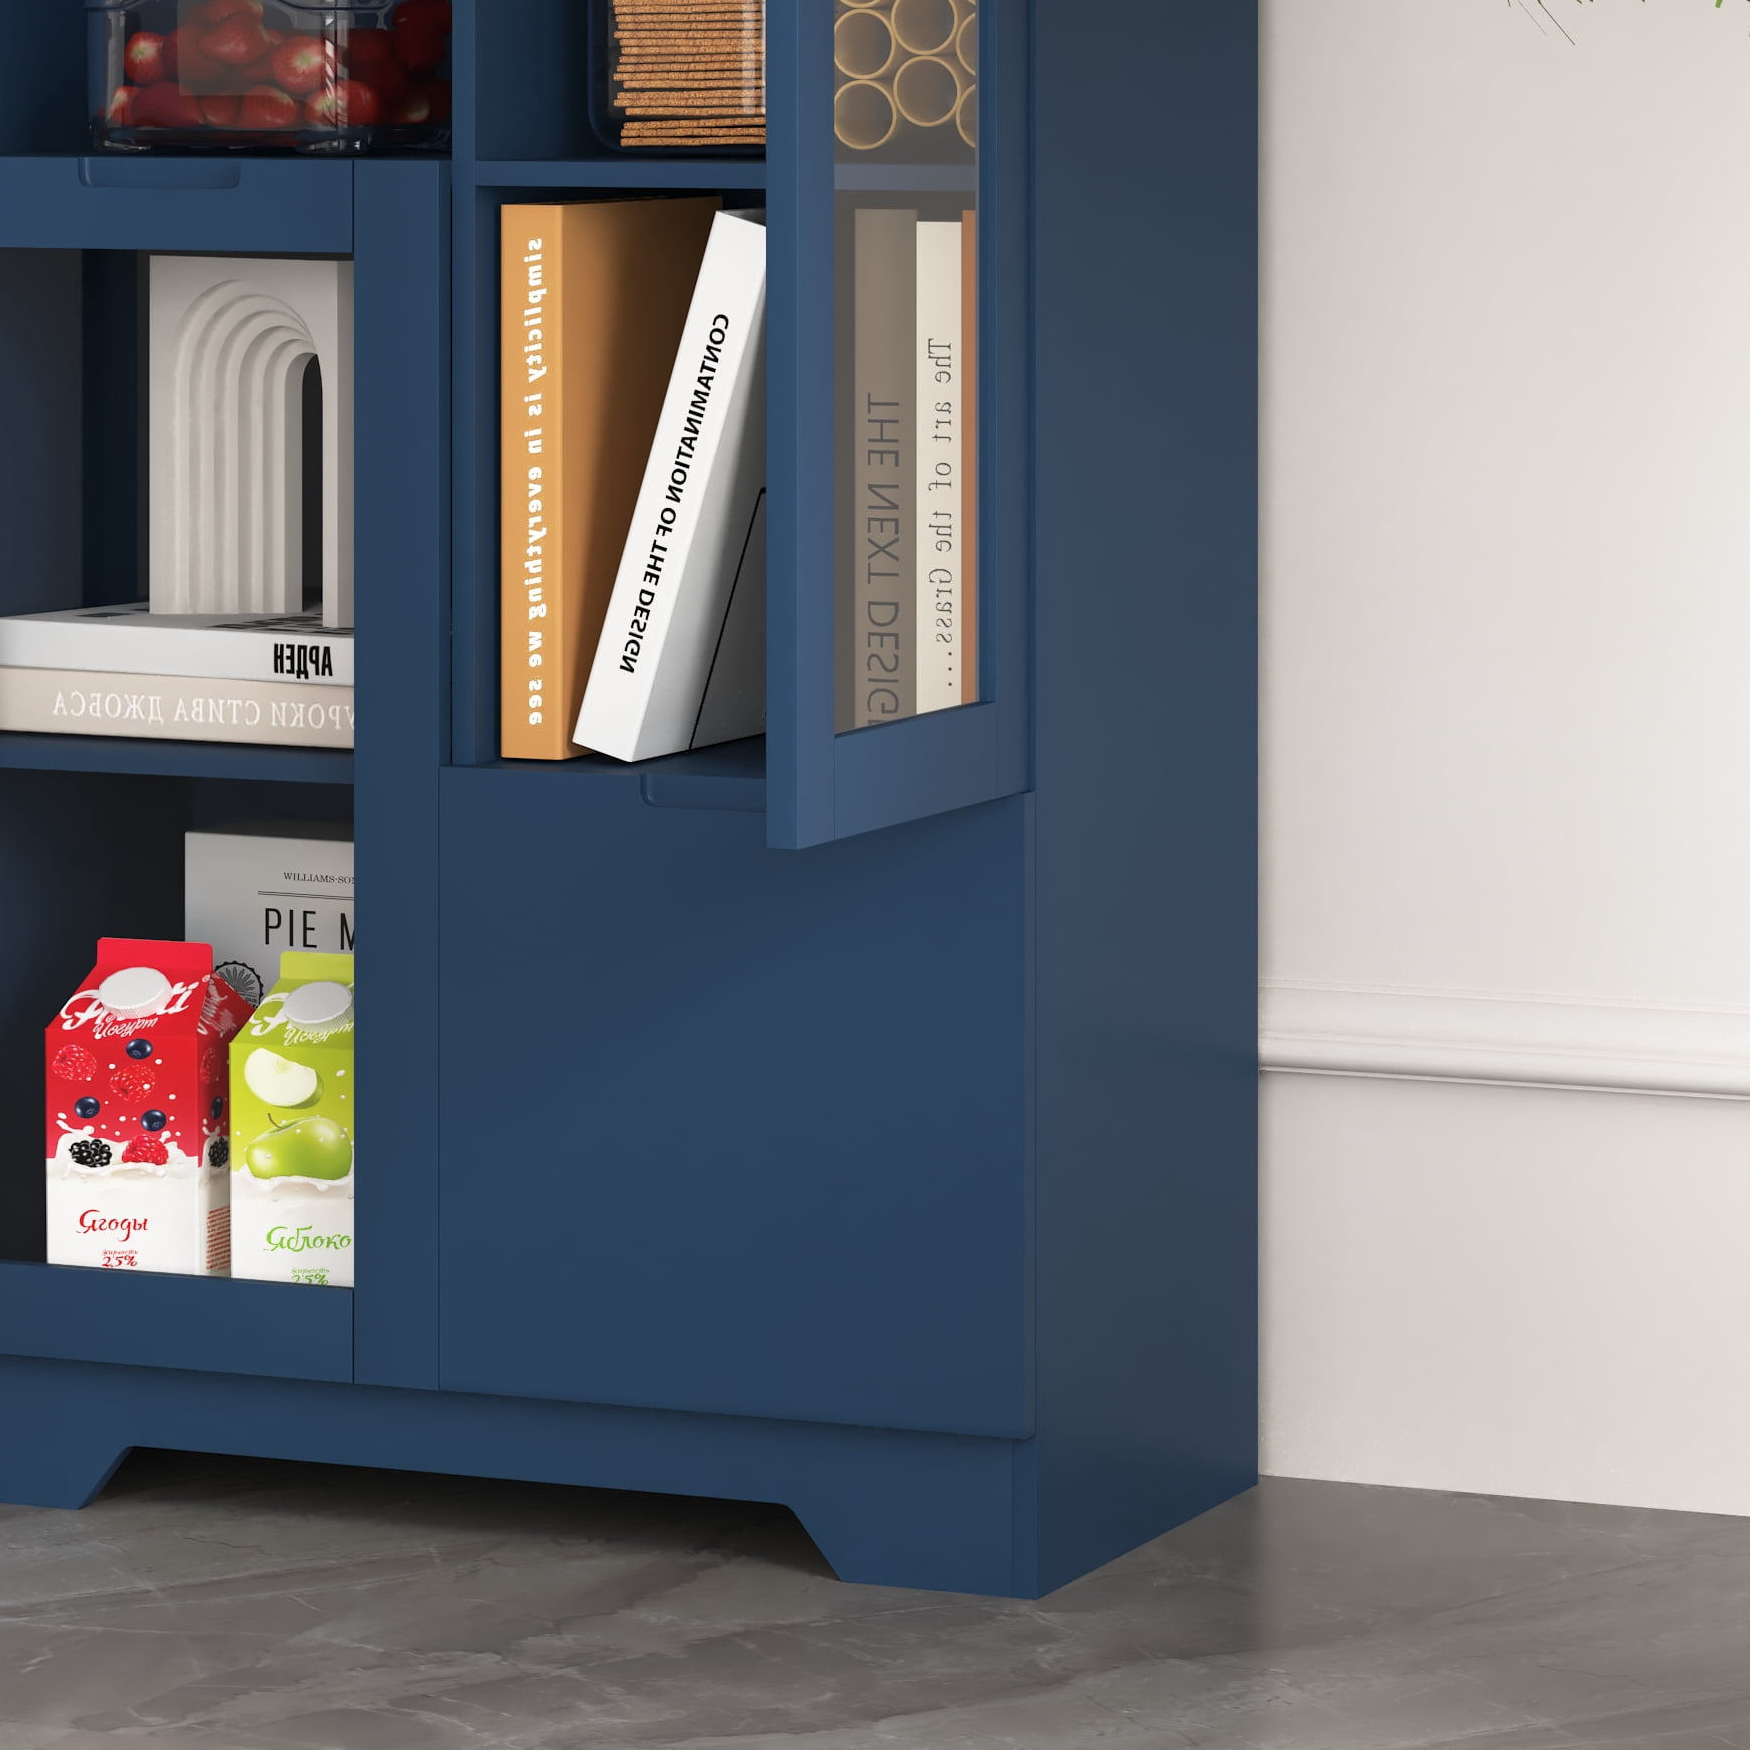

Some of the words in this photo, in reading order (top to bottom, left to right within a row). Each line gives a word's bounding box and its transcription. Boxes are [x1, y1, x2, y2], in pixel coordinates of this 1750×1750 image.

[265, 907, 317, 948] PIE
[75, 1209, 150, 1242] Ягоды
[262, 1225, 352, 1252] Яблоко
